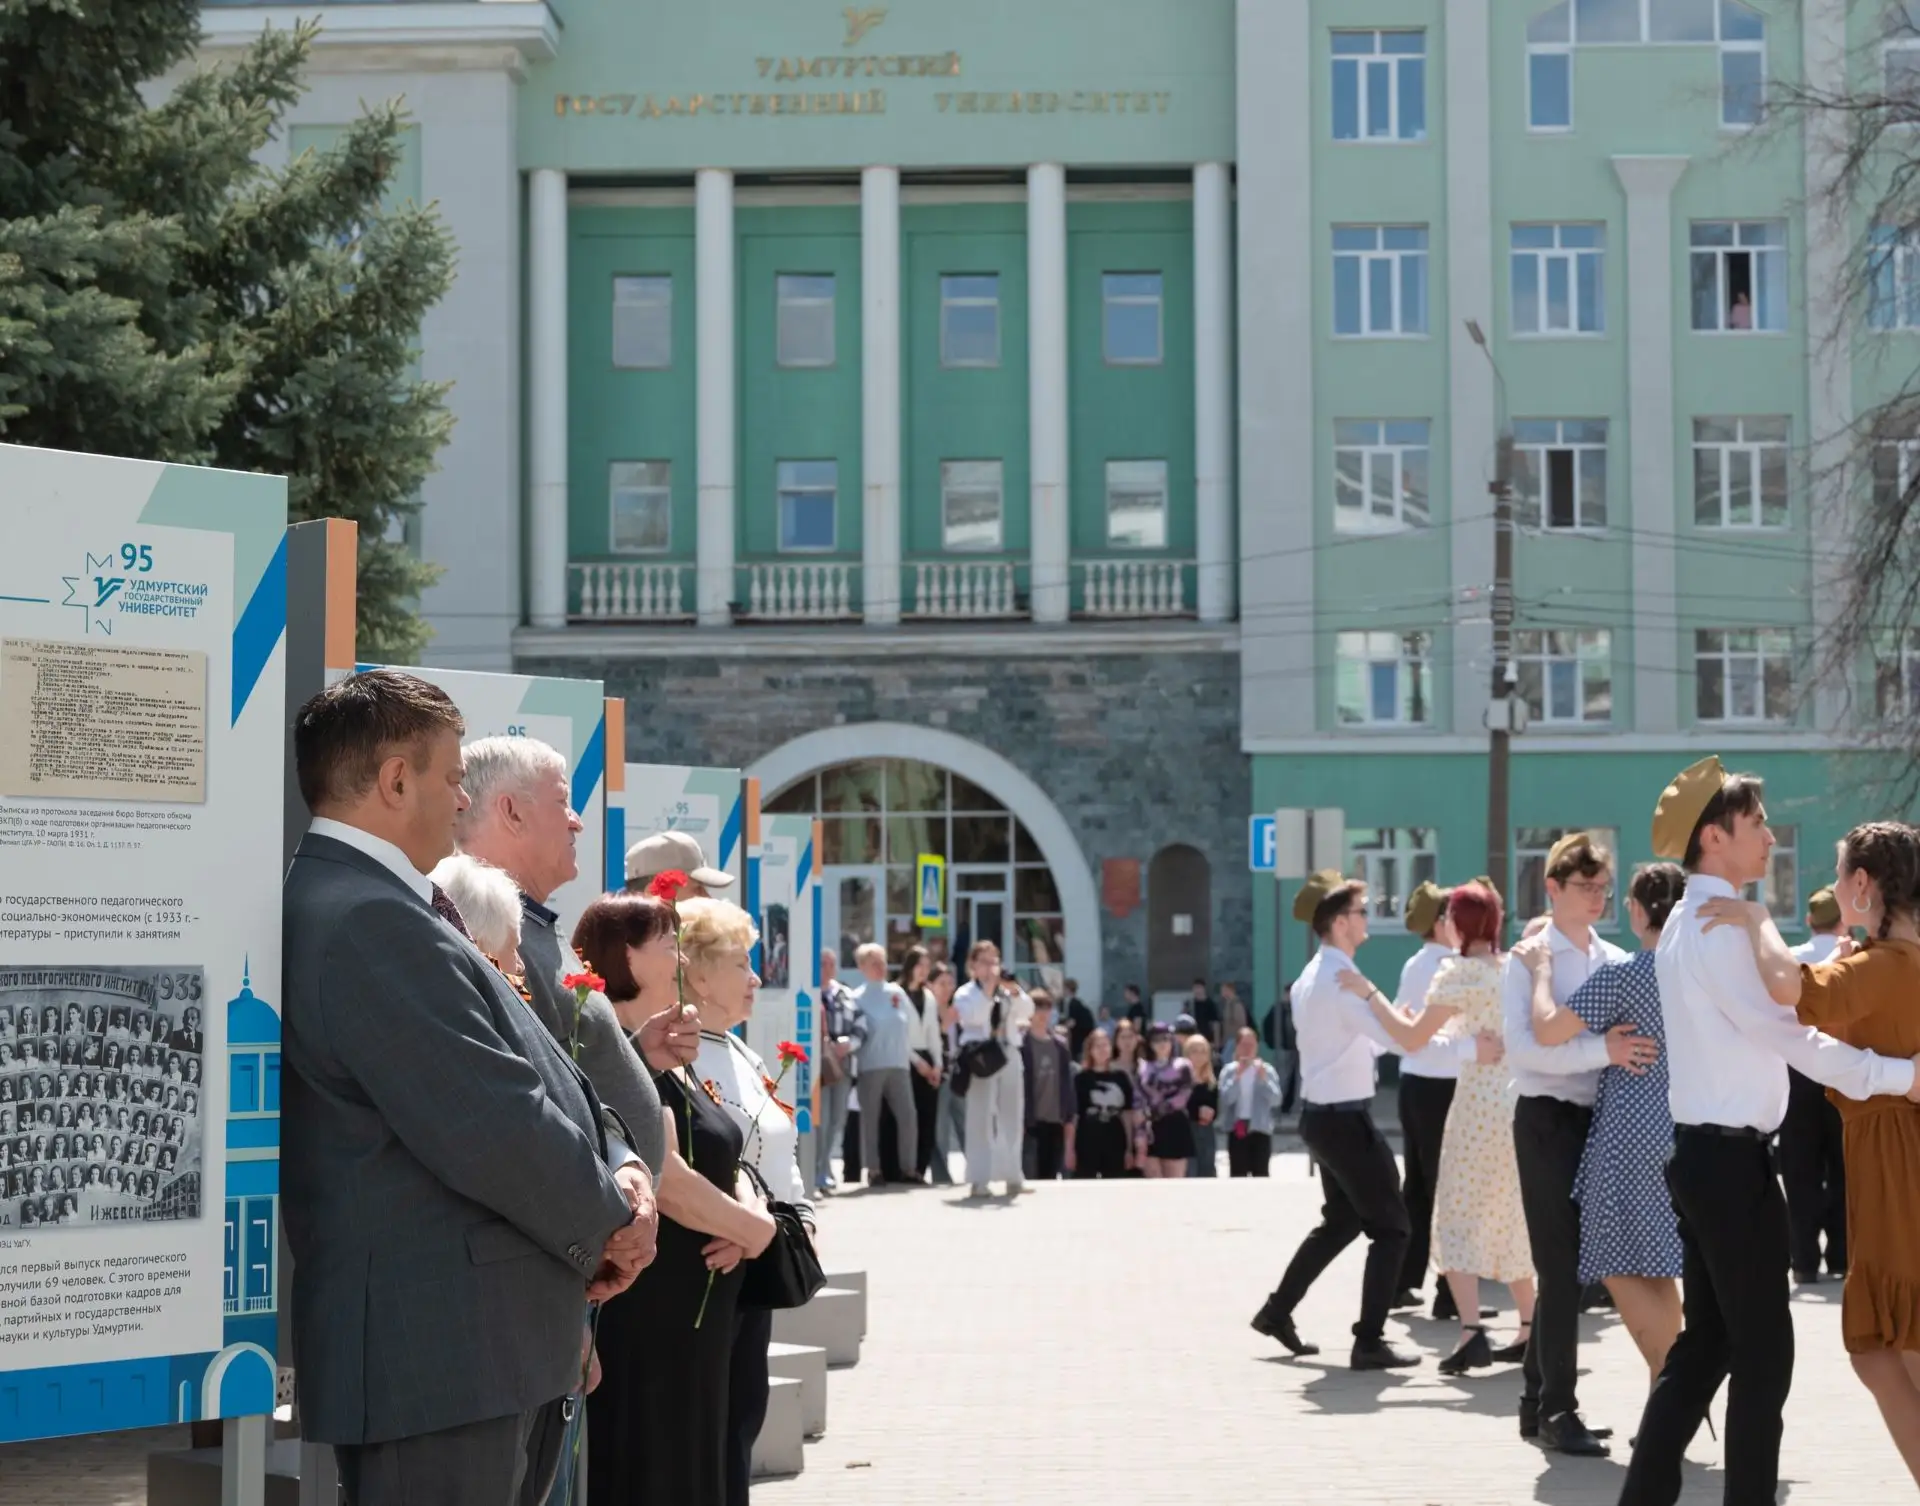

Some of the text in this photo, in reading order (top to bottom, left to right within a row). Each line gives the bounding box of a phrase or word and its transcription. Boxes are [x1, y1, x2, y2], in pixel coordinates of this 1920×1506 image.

[755, 51, 960, 82] УДМУРТСКИЙ
[554, 88, 885, 118] ГОСУДАРСТВЕННЫЙ
[120, 542, 153, 572] 95
[130, 579, 208, 596] УДМУРТСКИЙ
[124, 592, 203, 606] ГОСУДАРСТВЕННЫЙ
[118, 601, 197, 618] УНИВЕРСИТЕТ
[31, 807, 39, 815] из
[41, 807, 78, 816] протокола
[80, 808, 114, 817] заседания
[115, 810, 135, 819] бюро
[136, 810, 166, 820] Вотского
[167, 811, 192, 820] обкома
[675, 801, 689, 815] 95
[50, 820, 89, 828] подготовки
[90, 821, 135, 829] организации
[136, 822, 192, 831] педагогического
[48, 831, 68, 839] марта
[70, 830, 88, 838] 1931
[5, 895, 183, 908] государственного педагогического
[1, 911, 141, 924] социально-экономическом
[144, 912, 153, 925] (с
[156, 912, 182, 923] 1933
[185, 914, 191, 923] г.
[64, 929, 123, 942] приступили
[126, 930, 132, 939] к
[135, 930, 181, 939] занятиям
[21, 972, 101, 988] ПЕДАГОГИЧЕСКОГО
[152, 973, 202, 1001] 1935
[90, 1205, 142, 1221] ИЖЕВСК
[21, 1260, 61, 1275] первый
[64, 1259, 101, 1271] выпуск
[104, 1253, 187, 1267] педагогического
[45, 1276, 59, 1288] 69
[62, 1275, 106, 1287] человек.
[109, 1272, 116, 1283] С
[118, 1272, 145, 1283] этого
[147, 1269, 191, 1283] времени
[30, 1294, 61, 1306] базой
[64, 1291, 123, 1304] подготовки
[125, 1287, 162, 1300] кадров
[164, 1286, 182, 1297] для
[4, 1304, 162, 1327] партийных и государственных
[33, 1331, 40, 1340] и
[42, 1327, 90, 1341] культуры
[92, 1322, 144, 1336] Удмуртии.
